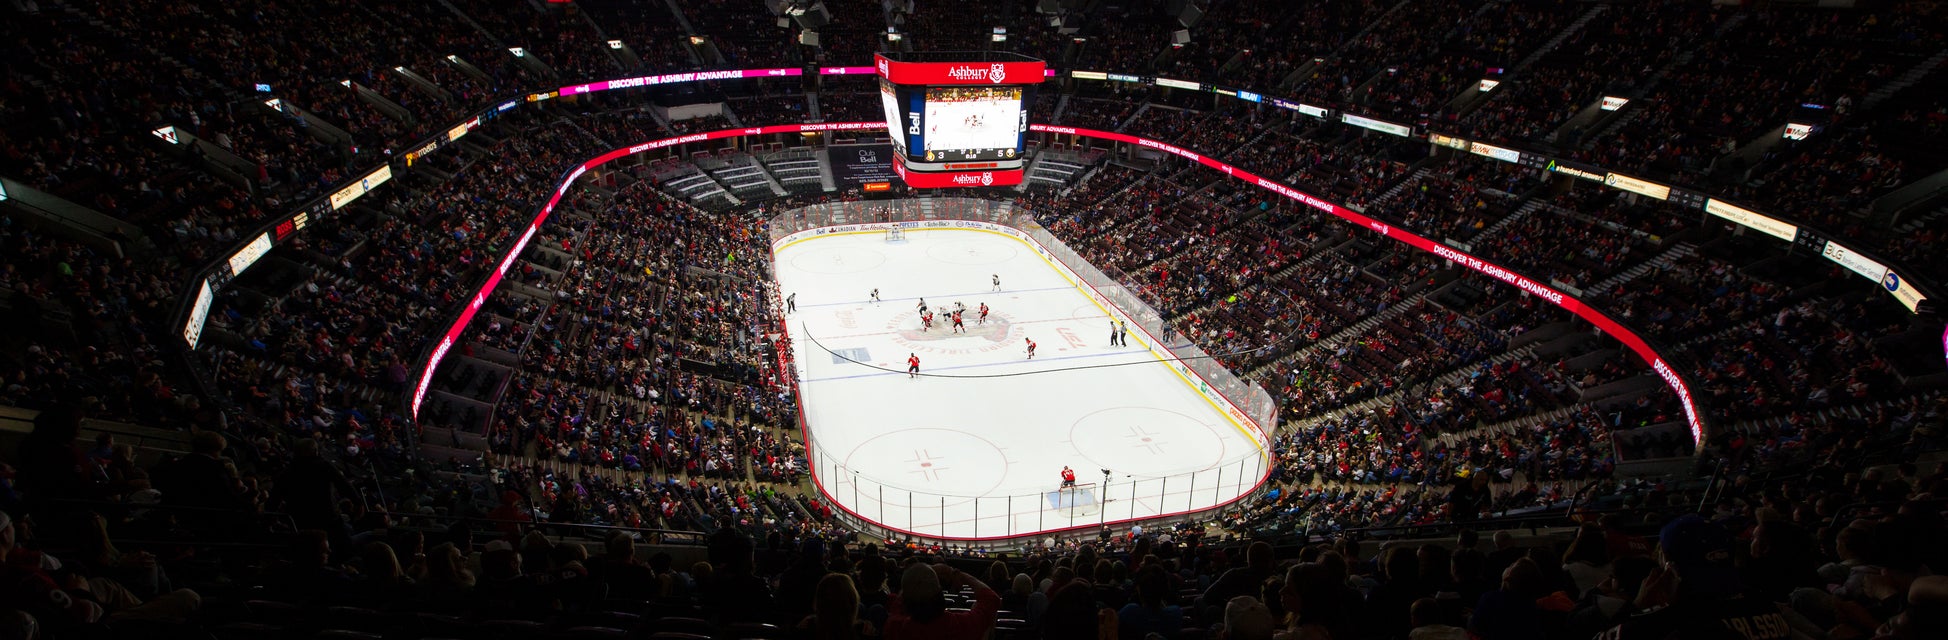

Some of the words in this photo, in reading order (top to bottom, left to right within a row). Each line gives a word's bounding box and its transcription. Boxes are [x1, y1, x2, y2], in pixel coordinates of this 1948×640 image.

[608, 78, 644, 88] DISCOVER
[645, 76, 659, 84] THE
[660, 73, 695, 83] ASHBURY
[696, 70, 743, 80] ADVANTAGE
[948, 65, 989, 79] Ashbury
[909, 112, 921, 135] Bell
[1020, 109, 1028, 133] Bell
[1046, 126, 1076, 134] ADVANTAGE
[953, 174, 982, 183] Ashbury
[1560, 166, 1582, 178] hundred
[1258, 179, 1278, 190] DISCOVER
[1305, 197, 1334, 212] ADVANTAGE
[1433, 245, 1467, 263] DISCOVER
[1468, 258, 1482, 269] THE
[1482, 264, 1517, 282] ASHBURY
[1516, 279, 1563, 303] ADVANTAGE
[1654, 358, 1680, 391] DISCOVER
[1229, 407, 1244, 421] pizza
[1242, 418, 1257, 434] pizza
